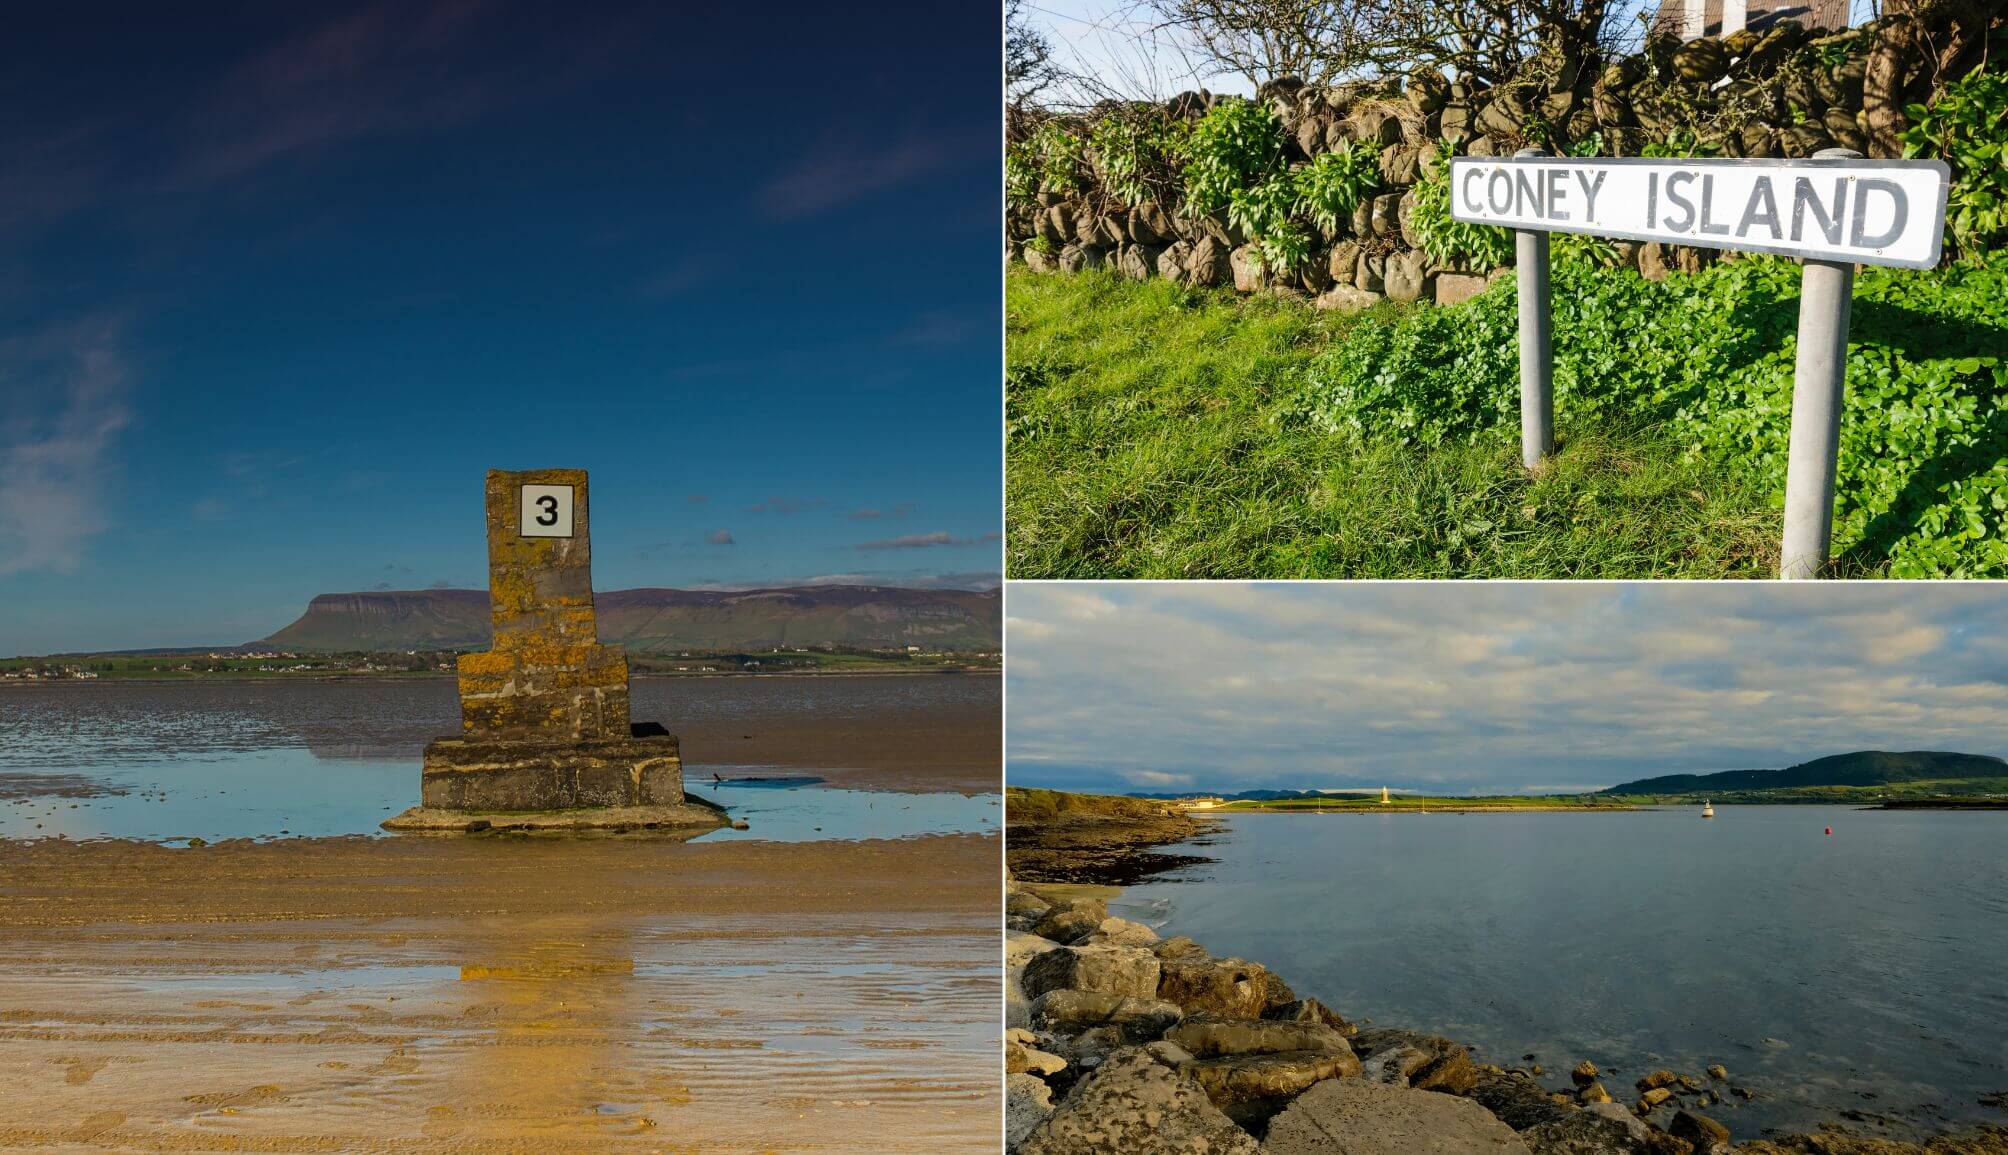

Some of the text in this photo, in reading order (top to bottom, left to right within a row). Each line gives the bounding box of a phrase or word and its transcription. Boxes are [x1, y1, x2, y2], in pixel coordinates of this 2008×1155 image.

[1462, 167, 1909, 249] CONEY ISLAND
[535, 495, 558, 526] 3
